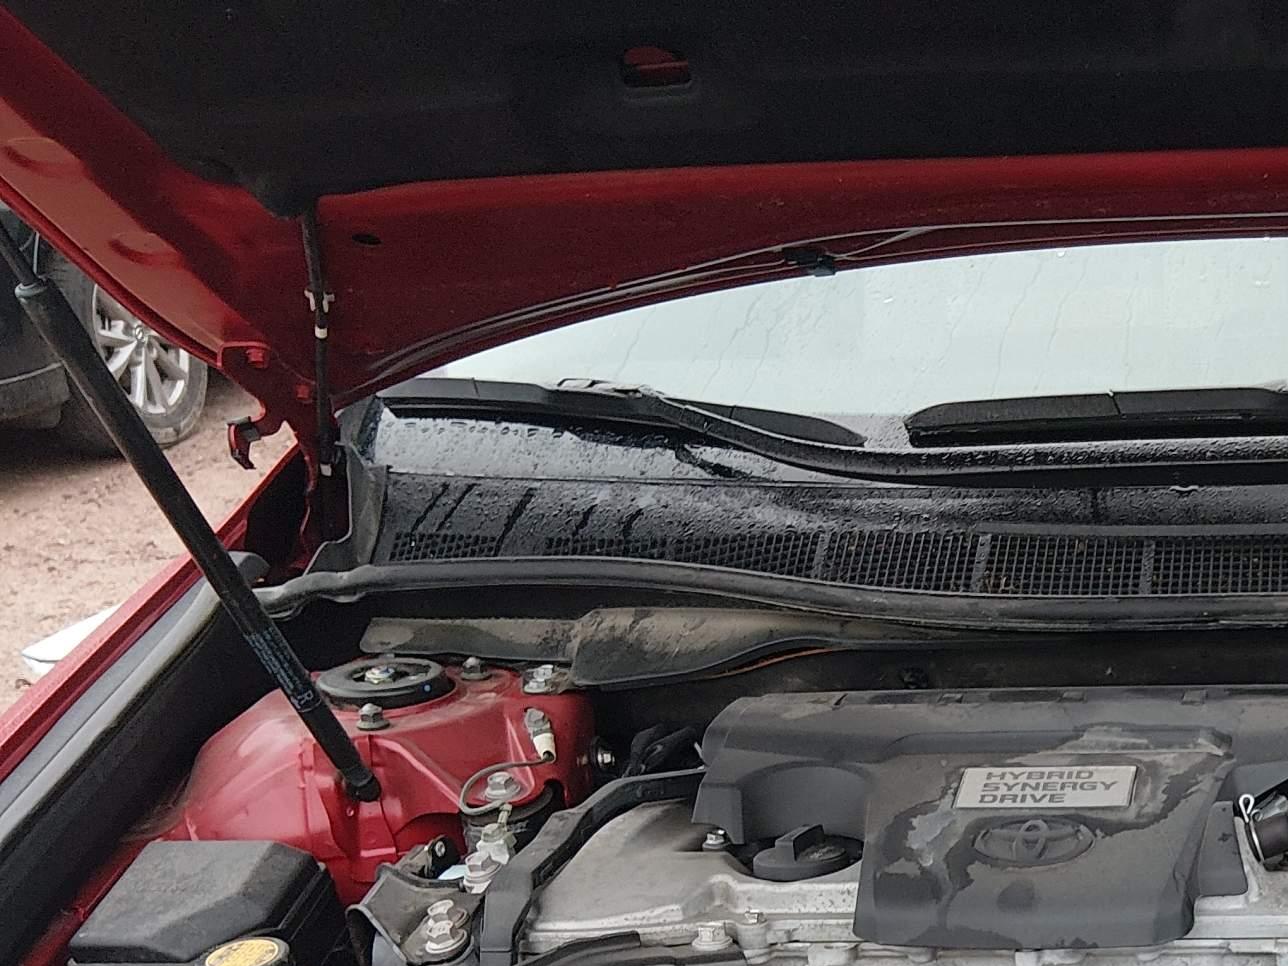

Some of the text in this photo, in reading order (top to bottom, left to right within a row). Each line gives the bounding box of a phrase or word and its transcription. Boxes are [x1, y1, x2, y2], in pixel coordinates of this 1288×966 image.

[986, 770, 1094, 781] HYBRID
[981, 780, 1119, 793] SYNERGY
[978, 793, 1067, 804] DRIVE
